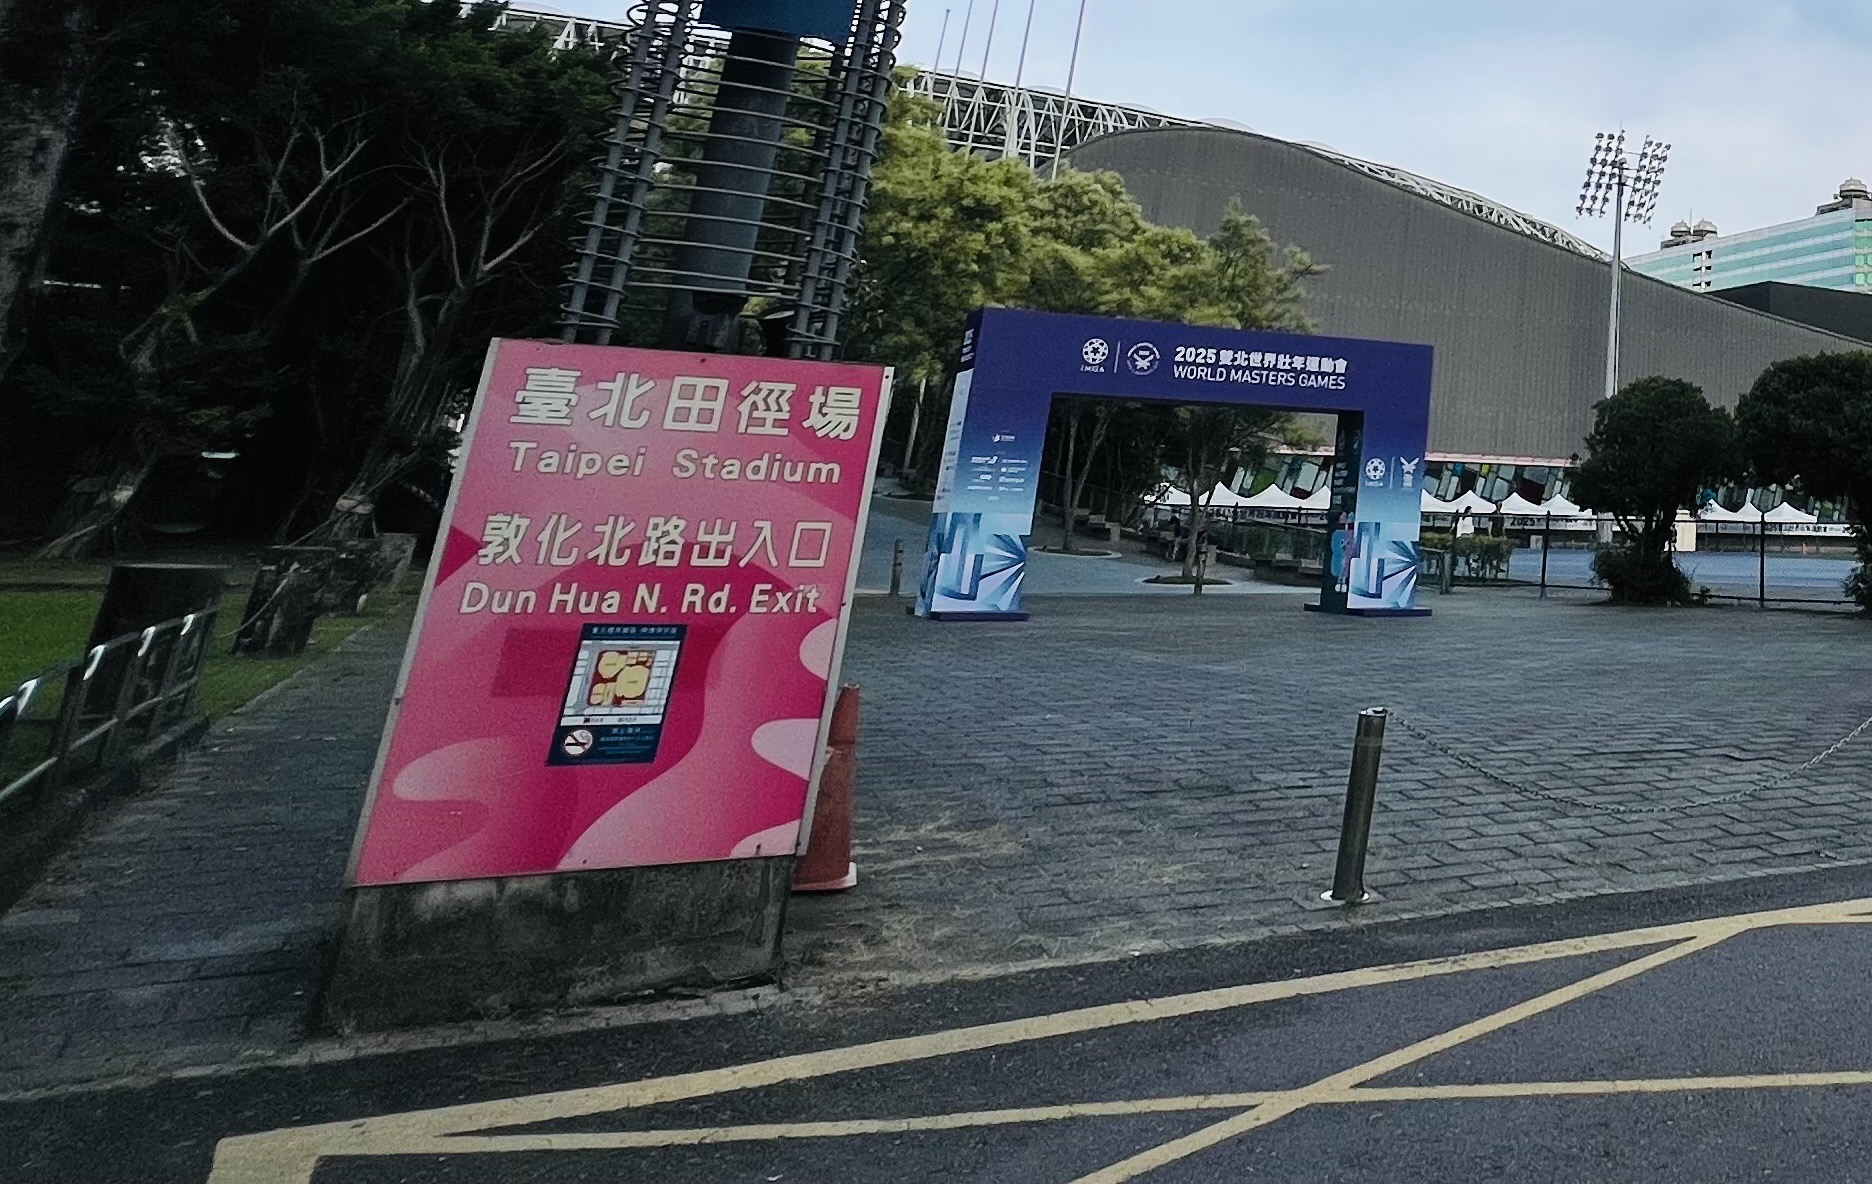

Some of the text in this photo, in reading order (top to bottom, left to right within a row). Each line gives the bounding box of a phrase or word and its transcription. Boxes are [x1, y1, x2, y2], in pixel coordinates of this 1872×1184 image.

[1175, 346, 1217, 364] 2025
[1173, 364, 1346, 390] WORLD MASTERS GAMES
[508, 367, 862, 441] 臺北田徑場
[509, 441, 842, 484] Taipei Stadium
[477, 512, 834, 569] 敦化北路出入口
[459, 582, 821, 615] Dun Hua N. Rd. Exit
